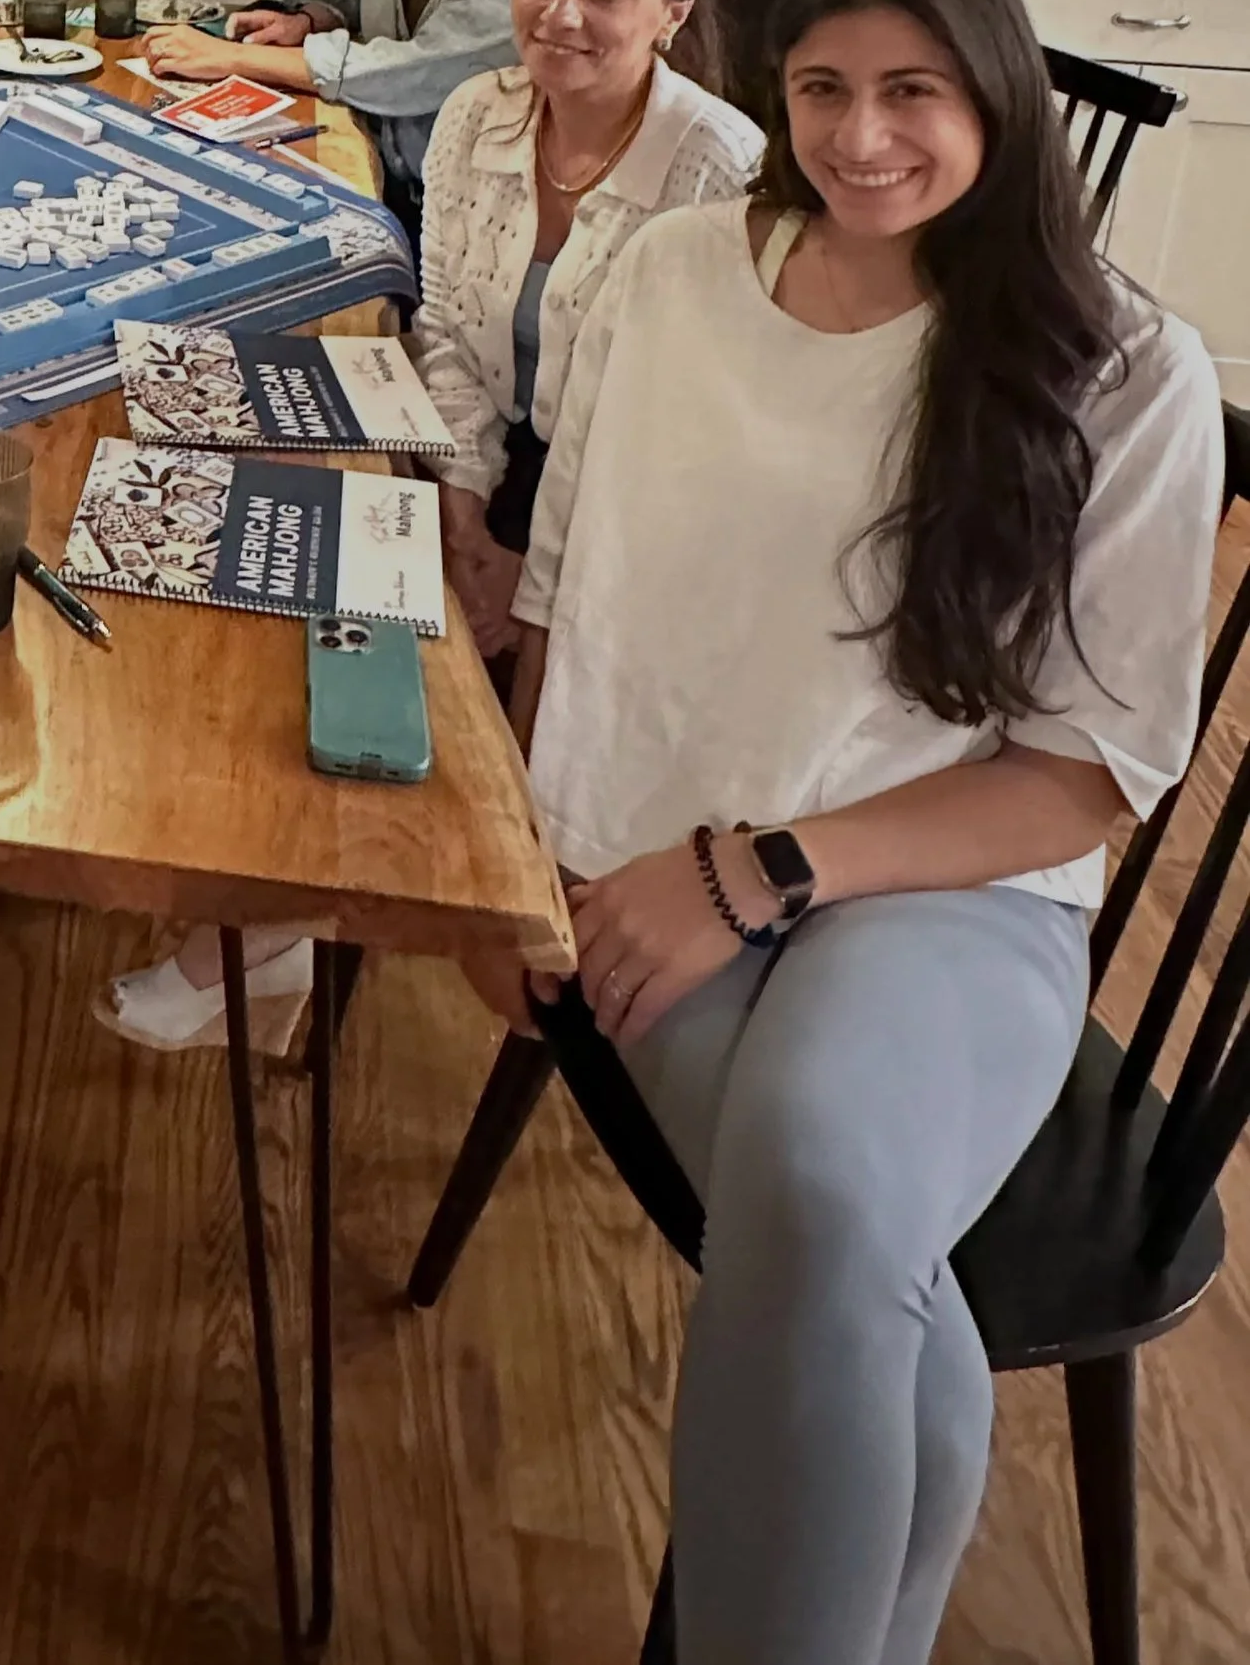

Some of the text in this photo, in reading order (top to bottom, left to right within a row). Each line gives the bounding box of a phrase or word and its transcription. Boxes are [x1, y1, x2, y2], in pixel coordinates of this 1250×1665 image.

[256, 363, 302, 436] AMERICAN
[282, 367, 331, 438] MAHJONG
[235, 496, 275, 592] AMERICAN
[267, 504, 303, 598] MAHJONG
[396, 491, 416, 538] Mahjong
